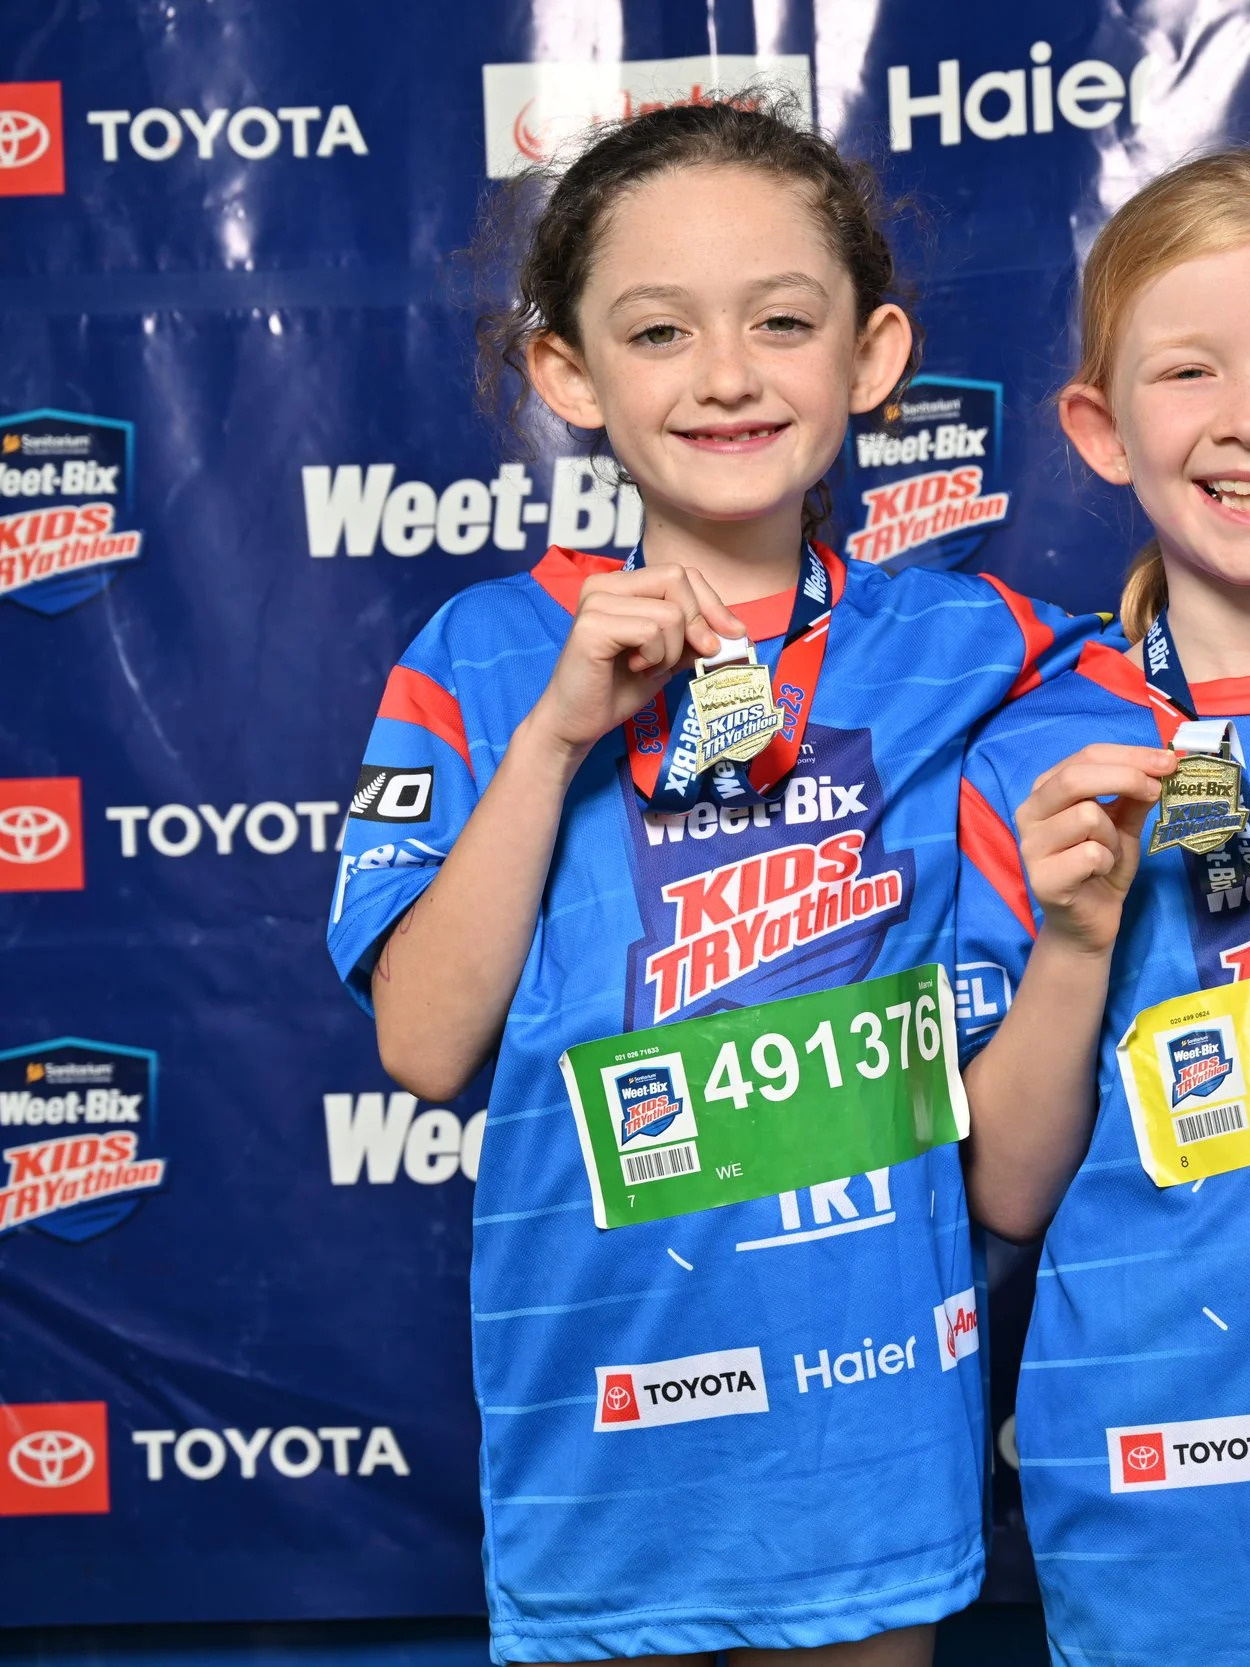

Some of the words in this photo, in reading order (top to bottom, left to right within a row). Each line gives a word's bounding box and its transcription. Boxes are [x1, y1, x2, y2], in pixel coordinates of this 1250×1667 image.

[87, 105, 370, 163] TOYOTA
[856, 423, 988, 468] Weet-Bix
[0, 460, 119, 496] eet-Bix
[865, 467, 980, 524] KIDS
[301, 455, 643, 557] Weet-Bi
[0, 532, 138, 588] RYathlon
[702, 714, 778, 761] TRYathlon
[706, 704, 764, 739] KIDS
[1166, 781, 1233, 797] Weet-Bix
[106, 801, 345, 858] TOYOT
[1168, 801, 1230, 823] KIDS
[664, 831, 864, 942] KIDS
[648, 871, 900, 1019] TRYathlon
[704, 995, 942, 1111] 491376
[1174, 1043, 1220, 1062] Weet-Bix
[1179, 1056, 1220, 1081] KIDS
[622, 1082, 668, 1100] Weet-Bix
[1176, 1064, 1229, 1098] TRYathlon
[0, 1089, 143, 1126] Weet-Bix
[625, 1103, 679, 1137] TRYathlon
[627, 1095, 669, 1120] KIDS
[6, 1132, 136, 1184] KIDS
[715, 1162, 743, 1181] WE
[1181, 1155, 1189, 1168] 8
[627, 1194, 636, 1208] 7
[794, 1336, 916, 1394] Haier
[643, 1370, 757, 1406] TOYOTA
[132, 1426, 411, 1481] TOYOTA
